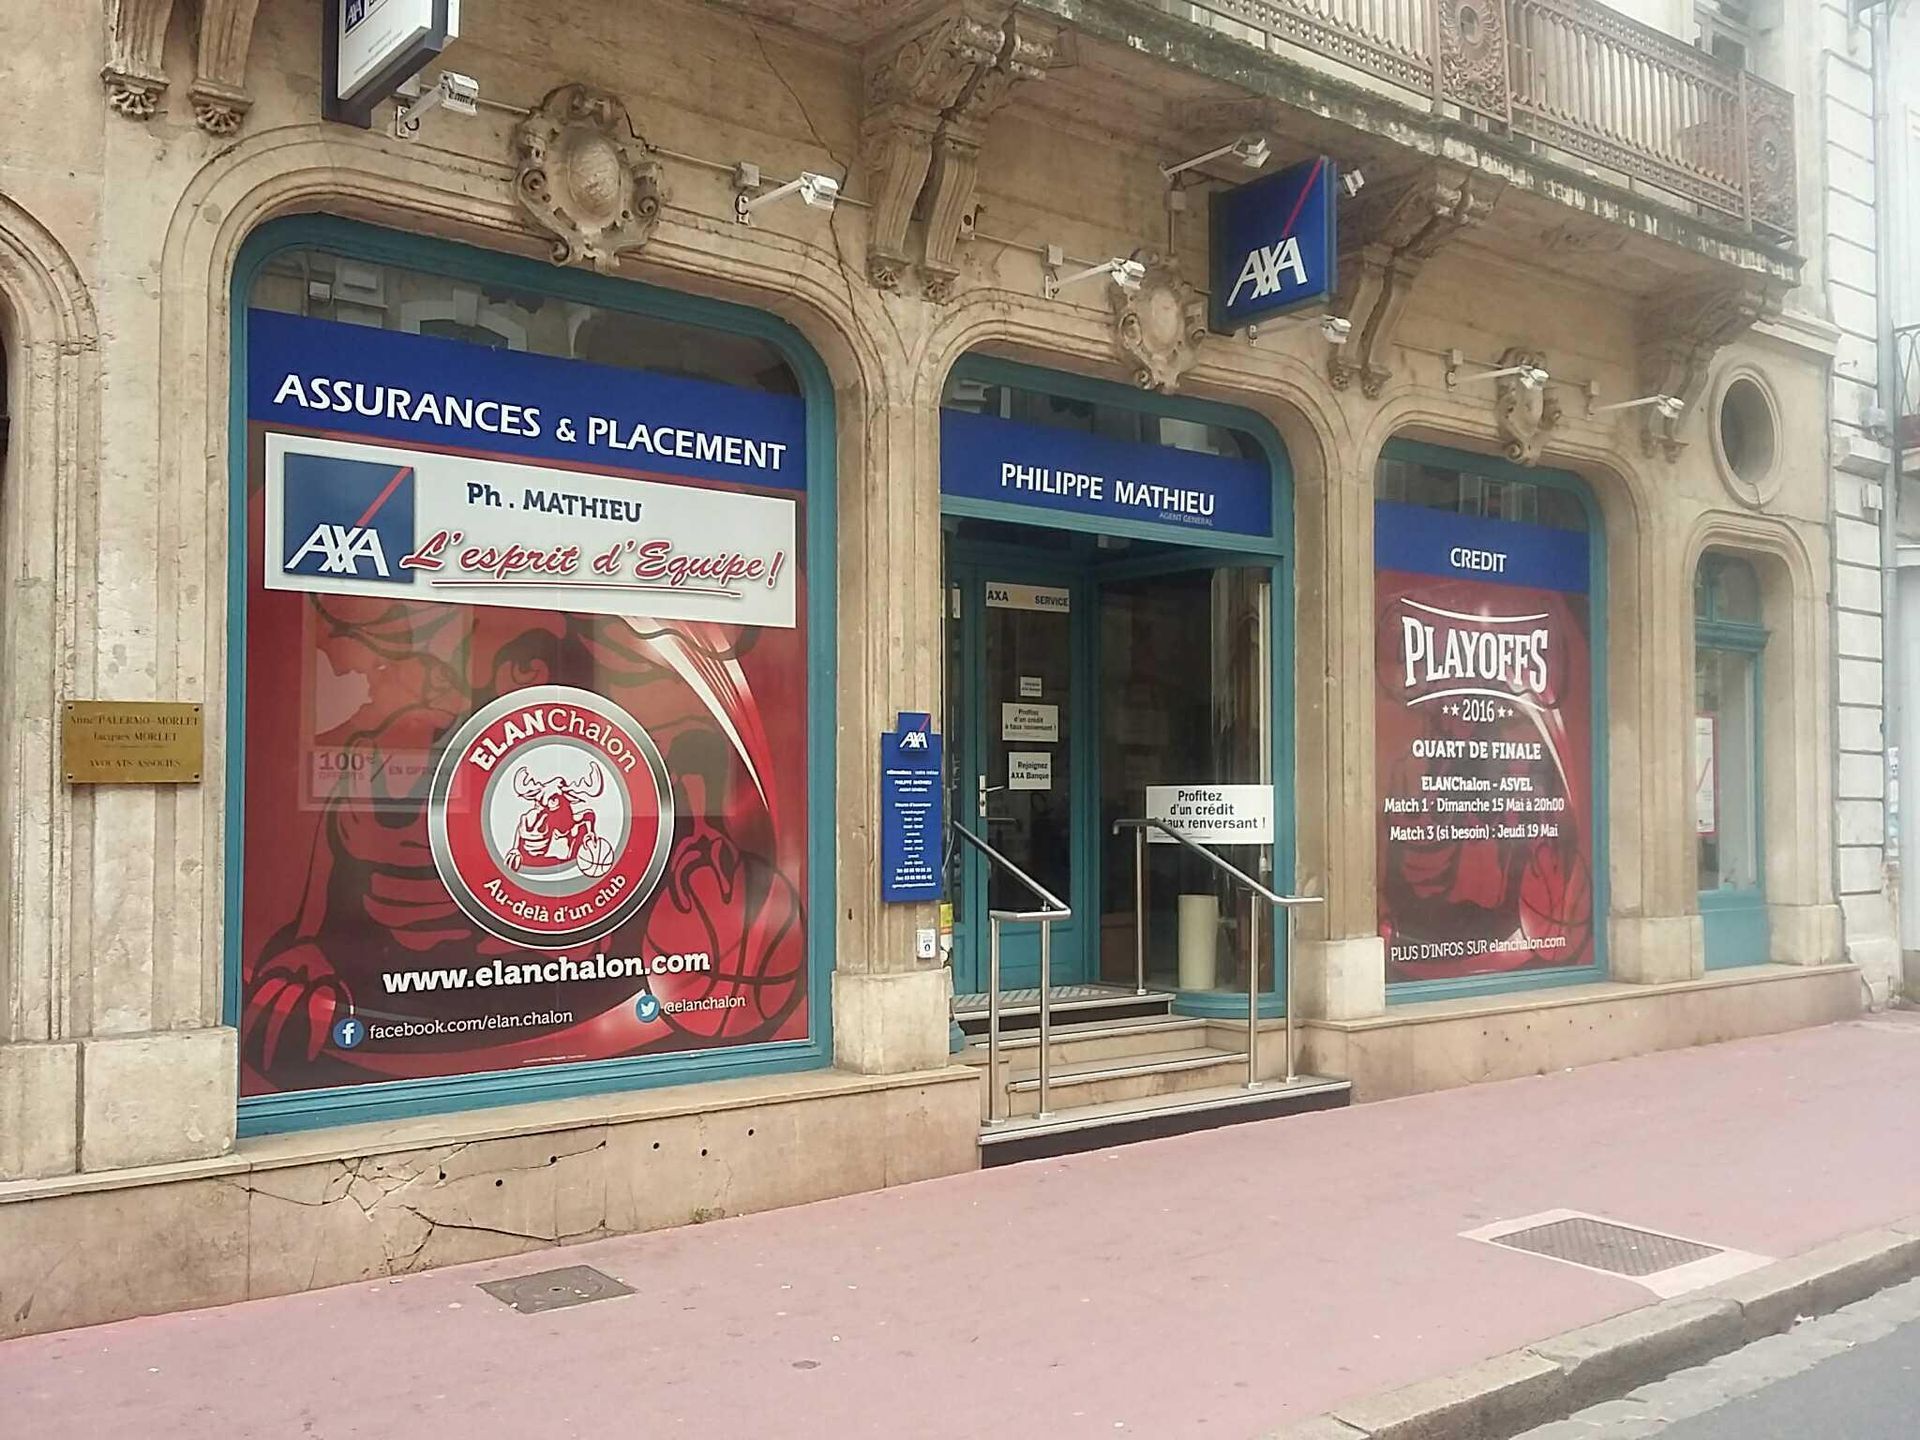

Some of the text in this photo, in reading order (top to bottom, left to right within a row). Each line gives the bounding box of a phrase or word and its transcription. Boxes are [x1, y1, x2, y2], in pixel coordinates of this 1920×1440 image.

[1227, 237, 1307, 306] AXA
[273, 374, 787, 470] ASSURANCES & PLACEMENT
[1001, 462, 1215, 516] PHILIPPE MATHIEU
[523, 489, 642, 522] MATHIEU
[1159, 512, 1182, 523] AGENT
[285, 524, 390, 577] AXA
[400, 530, 580, 579] L'esprit
[1450, 547, 1507, 573] CREDIT
[987, 590, 1068, 606] AXA SERVICE
[1402, 616, 1548, 693] PLAYOFFS
[1462, 699, 1495, 722] 2016
[469, 708, 637, 772] ELANChalon
[900, 732, 928, 748] AXA
[1412, 740, 1541, 760] QUART DE FINALE
[1011, 772, 1050, 781] AXA Banque
[1017, 761, 1048, 771] Rejoignez
[1421, 776, 1490, 791] ELANChalon
[1500, 777, 1532, 791] ASVEL
[1178, 790, 1222, 801] Profitez
[1384, 798, 1420, 813] Match
[1421, 798, 1428, 812] 1
[1436, 798, 1489, 812] Dimanche
[1492, 797, 1503, 811] 15
[1506, 798, 1524, 812] Mai
[1526, 799, 1532, 811] à
[1534, 798, 1564, 811] 20h00
[1170, 803, 1235, 816] d'un crédit
[1188, 817, 1258, 829] renversant
[1390, 826, 1424, 841] Match
[1427, 826, 1434, 840] 3
[1436, 826, 1449, 841] (si
[1451, 825, 1489, 840] besoin)
[1497, 824, 1525, 838] Jeudi
[1527, 824, 1538, 837] 19
[1540, 824, 1558, 837] Mai
[483, 874, 627, 923] Au-delà d'un club
[1391, 936, 1565, 961] PLUS D'INFOS SUR elanchalon.com
[383, 950, 711, 994] www.elanchalon.com
[663, 994, 747, 1013] @elanchalon
[369, 1010, 574, 1040] facebook.com/elan.chalon
